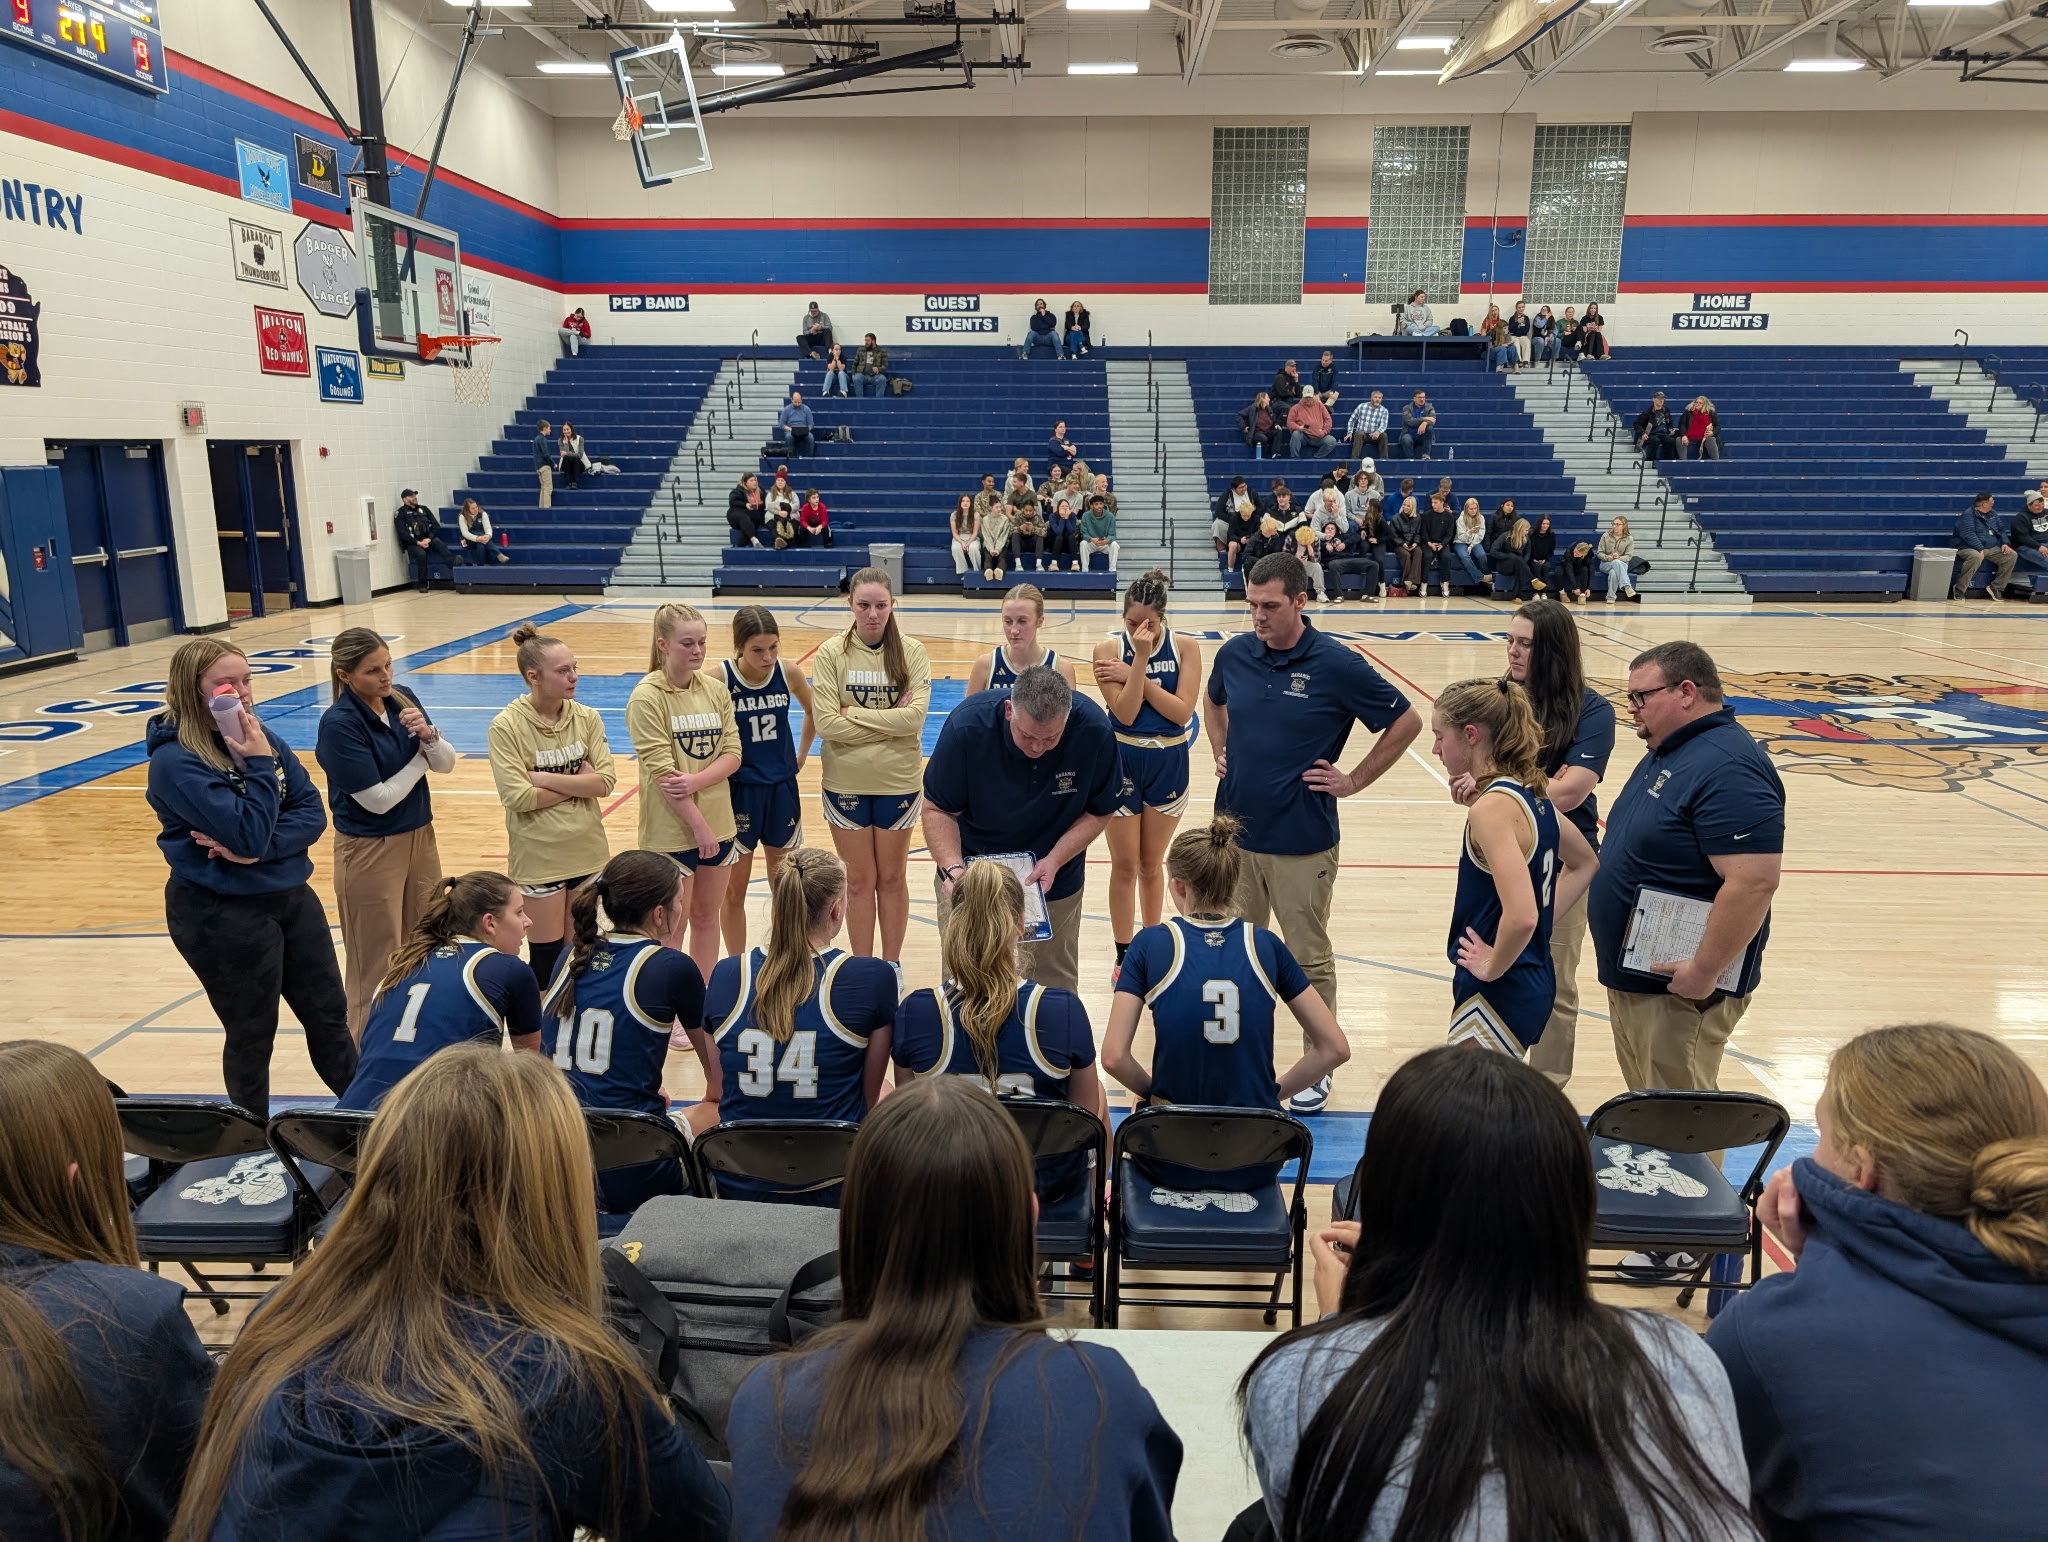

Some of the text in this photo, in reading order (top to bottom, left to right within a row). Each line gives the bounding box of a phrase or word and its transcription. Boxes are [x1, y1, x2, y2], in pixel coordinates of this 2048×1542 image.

[12, 22, 35, 37] SCORE
[130, 27, 148, 41] FOULS
[76, 46, 98, 61] MATCH
[136, 40, 150, 71] 9
[135, 69, 154, 83] SCORE
[0, 179, 83, 235] NTRY
[241, 227, 274, 251] BARABOO
[306, 237, 349, 264] BADGER
[241, 261, 280, 283] THUNDERBIRDS
[312, 283, 350, 306] LARGE
[467, 283, 480, 294] Good
[612, 296, 686, 310] PEP BAND
[926, 296, 978, 310] GUEST
[1699, 295, 1747, 309] HOME
[261, 314, 302, 335] MILTON
[911, 317, 993, 331] STUDENTS
[1678, 315, 1763, 328] STUDENTS
[265, 345, 304, 363] RED HAWKS
[321, 353, 356, 371] WATERTOWN
[329, 384, 354, 397] GOSLINGS
[749, 713, 778, 743] 12
[1542, 848, 1554, 908] 2
[393, 983, 431, 1043] 1
[1202, 979, 1240, 1044] 3
[553, 1006, 615, 1076] 10
[737, 1028, 819, 1099] 34
[620, 1241, 645, 1264] 3
